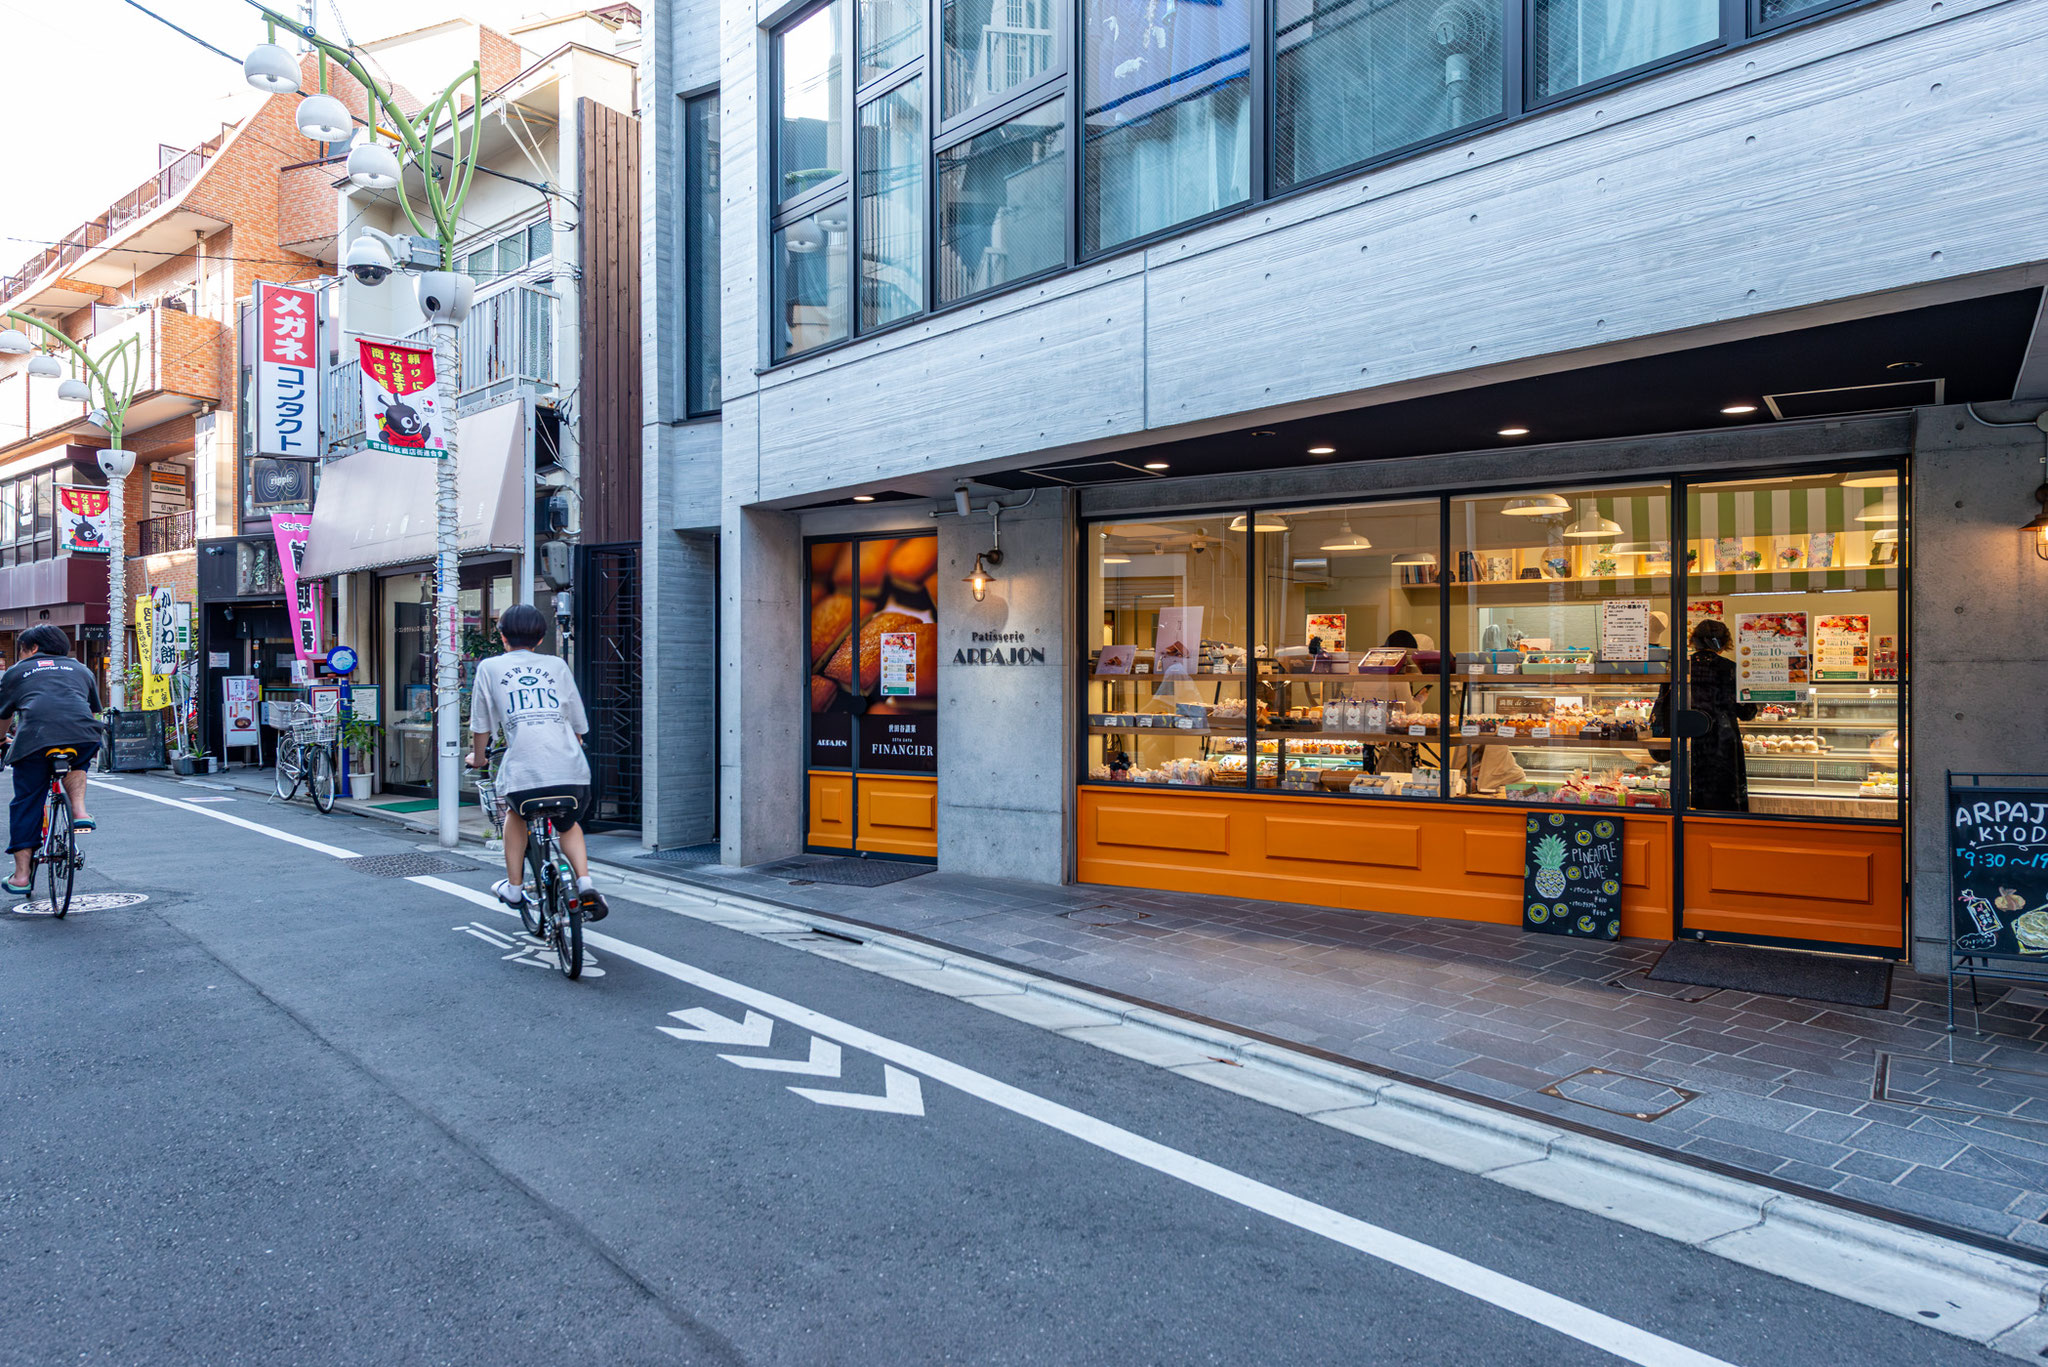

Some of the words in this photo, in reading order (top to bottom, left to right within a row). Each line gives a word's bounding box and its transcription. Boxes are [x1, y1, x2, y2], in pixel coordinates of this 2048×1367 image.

[272, 295, 308, 361] メガネ
[389, 351, 406, 392] なります
[407, 353, 424, 391] 頼りに
[275, 366, 305, 451] コンタクト
[270, 474, 293, 486] ripple
[160, 591, 176, 664] かしわ餅
[971, 631, 1025, 643] Patisserie
[953, 646, 1045, 666] ARPAJON
[500, 666, 522, 686] NEW
[526, 666, 556, 685] YORK
[506, 687, 560, 714] JETS
[816, 739, 848, 747] ARPAJON
[871, 743, 934, 756] FINANCIER
